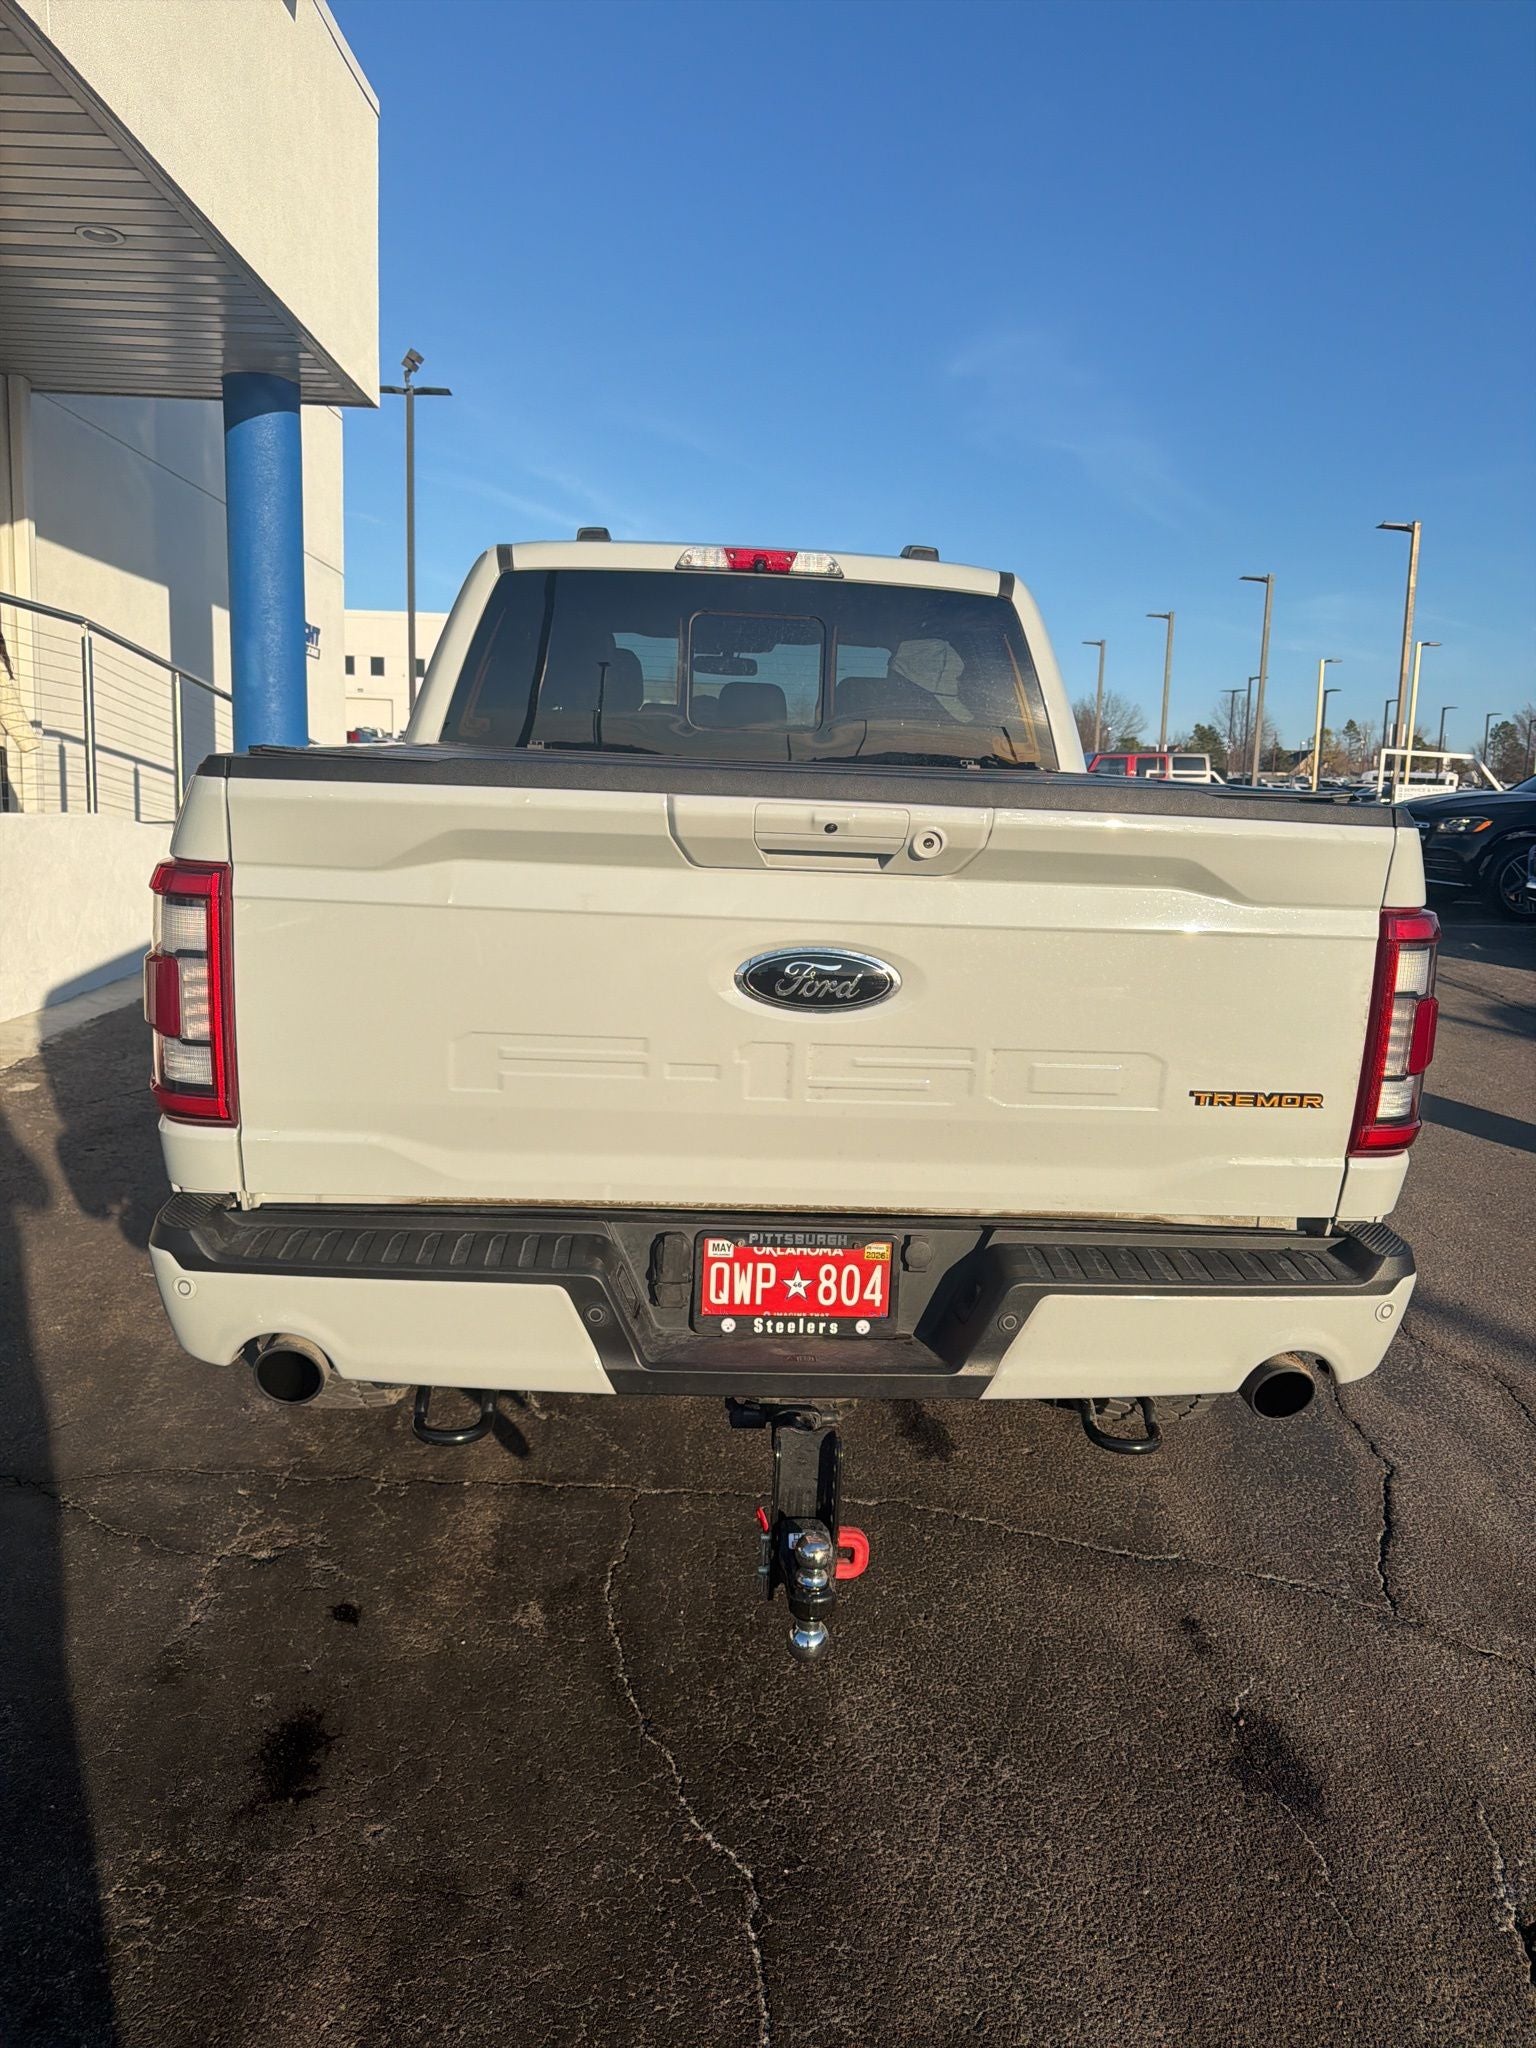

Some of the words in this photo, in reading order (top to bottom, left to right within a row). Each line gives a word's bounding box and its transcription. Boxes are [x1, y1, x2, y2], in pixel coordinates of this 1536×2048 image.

[774, 960, 863, 999] Ford
[448, 1031, 1166, 1112] F-150
[1189, 1090, 1324, 1109] TREMOR
[712, 1242, 732, 1252] MAY
[749, 1233, 848, 1246] PITTSBURGH
[866, 1251, 886, 1260] 2026
[709, 1261, 776, 1305] QWP
[817, 1263, 883, 1307] 804
[753, 1317, 839, 1335] Steelers
